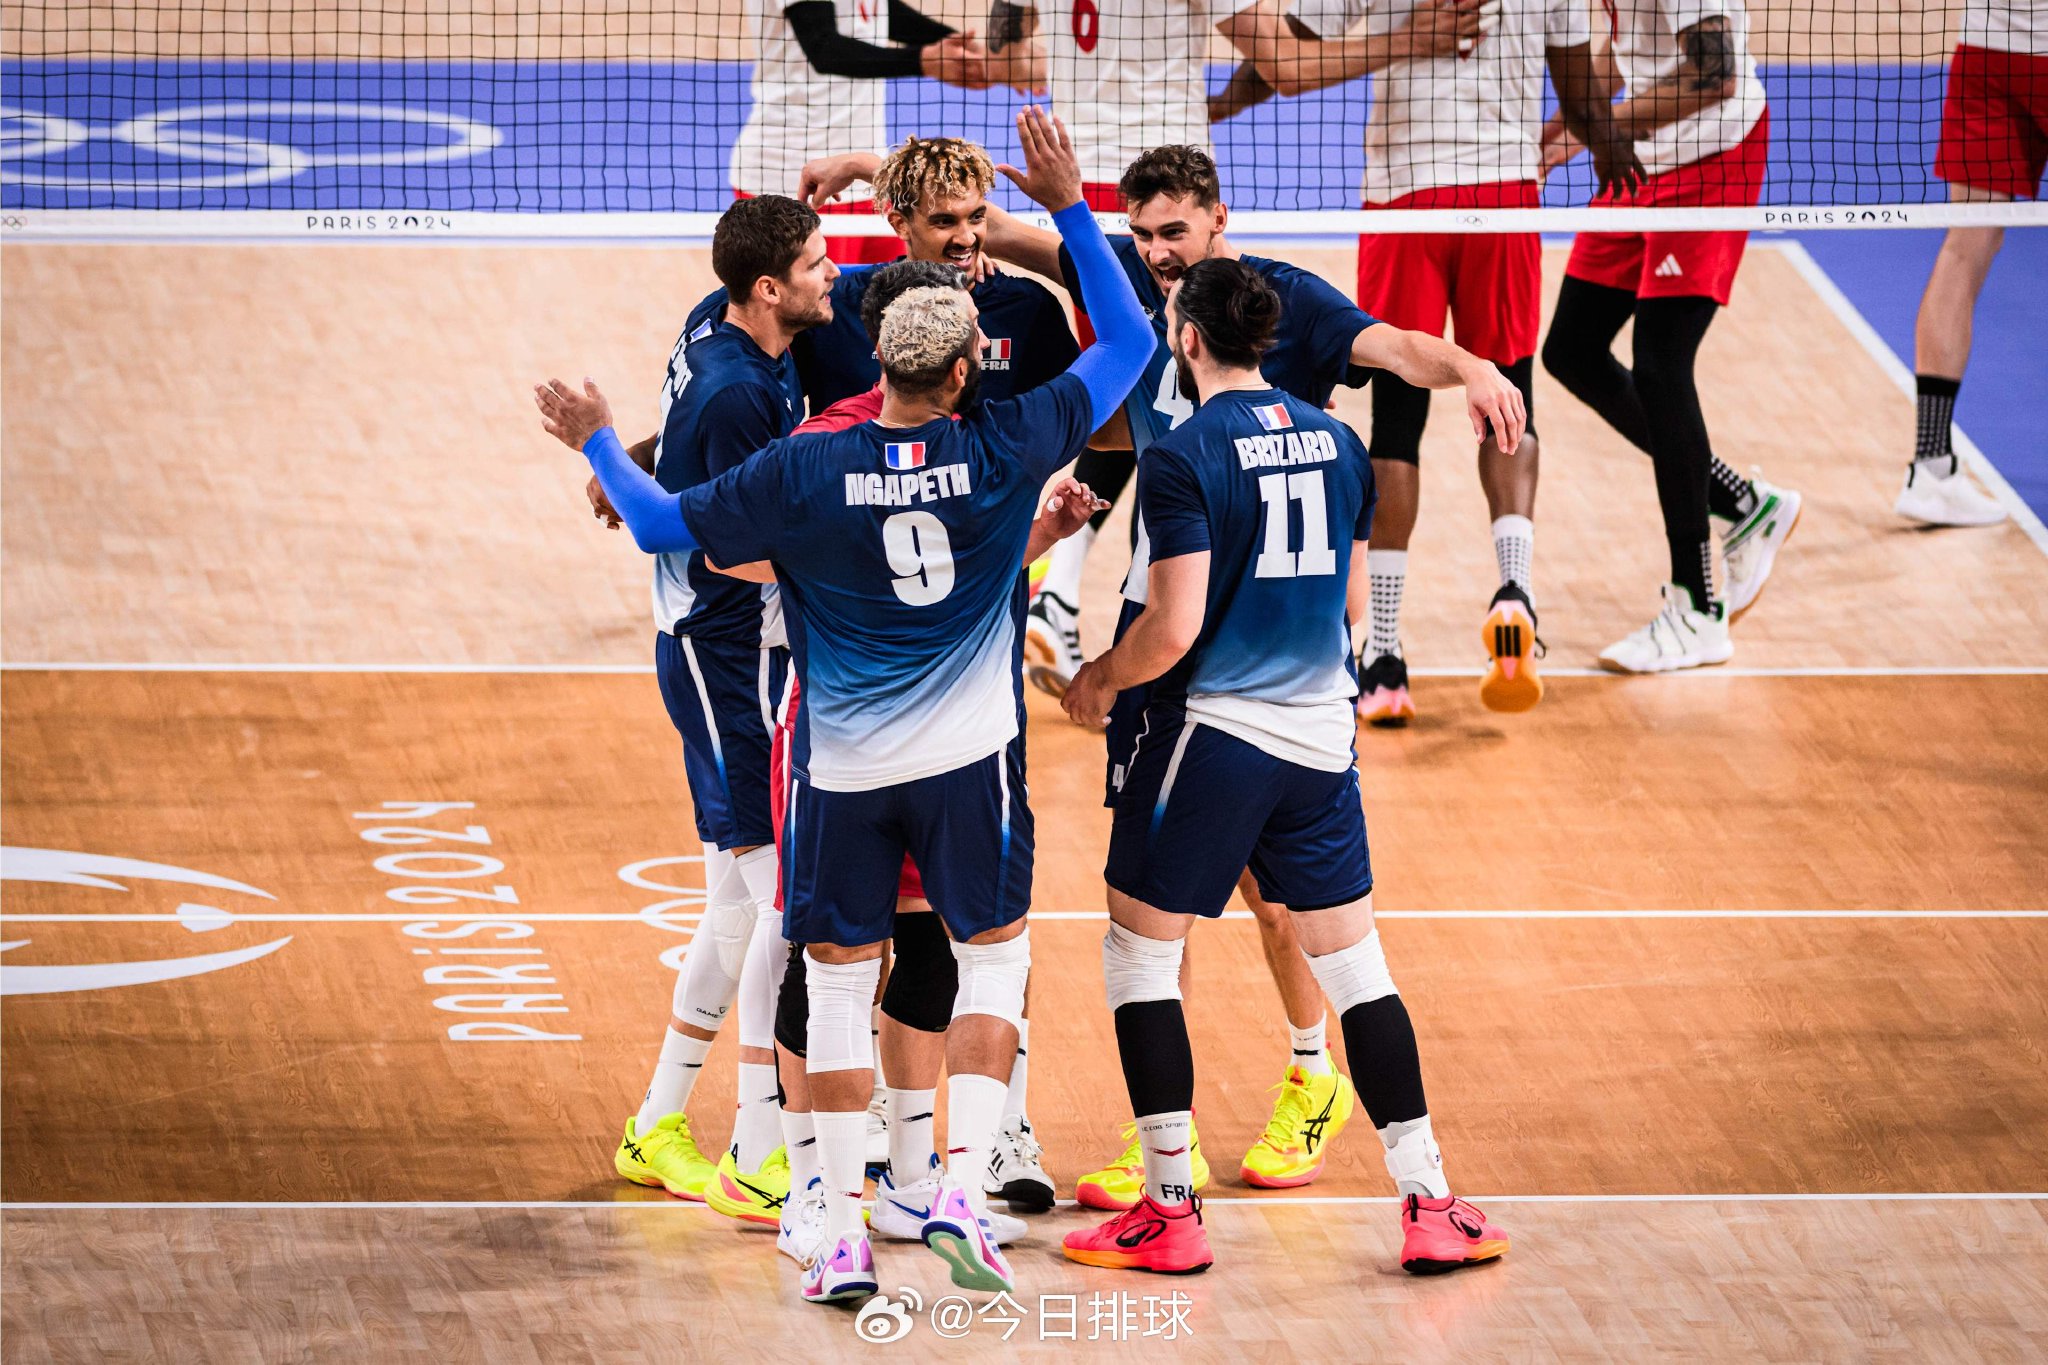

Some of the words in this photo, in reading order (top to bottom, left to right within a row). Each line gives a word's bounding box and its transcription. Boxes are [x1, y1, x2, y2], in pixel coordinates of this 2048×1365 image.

[388, 215, 451, 230] 2024
[1845, 210, 1908, 224] 2024
[980, 360, 1010, 371] FRA
[1153, 356, 1194, 431] 4
[1233, 430, 1338, 471] BRIZARD
[845, 463, 971, 506] NGAPETH
[1254, 469, 1337, 579] 11
[882, 510, 955, 607] 9
[352, 801, 520, 905] 2024
